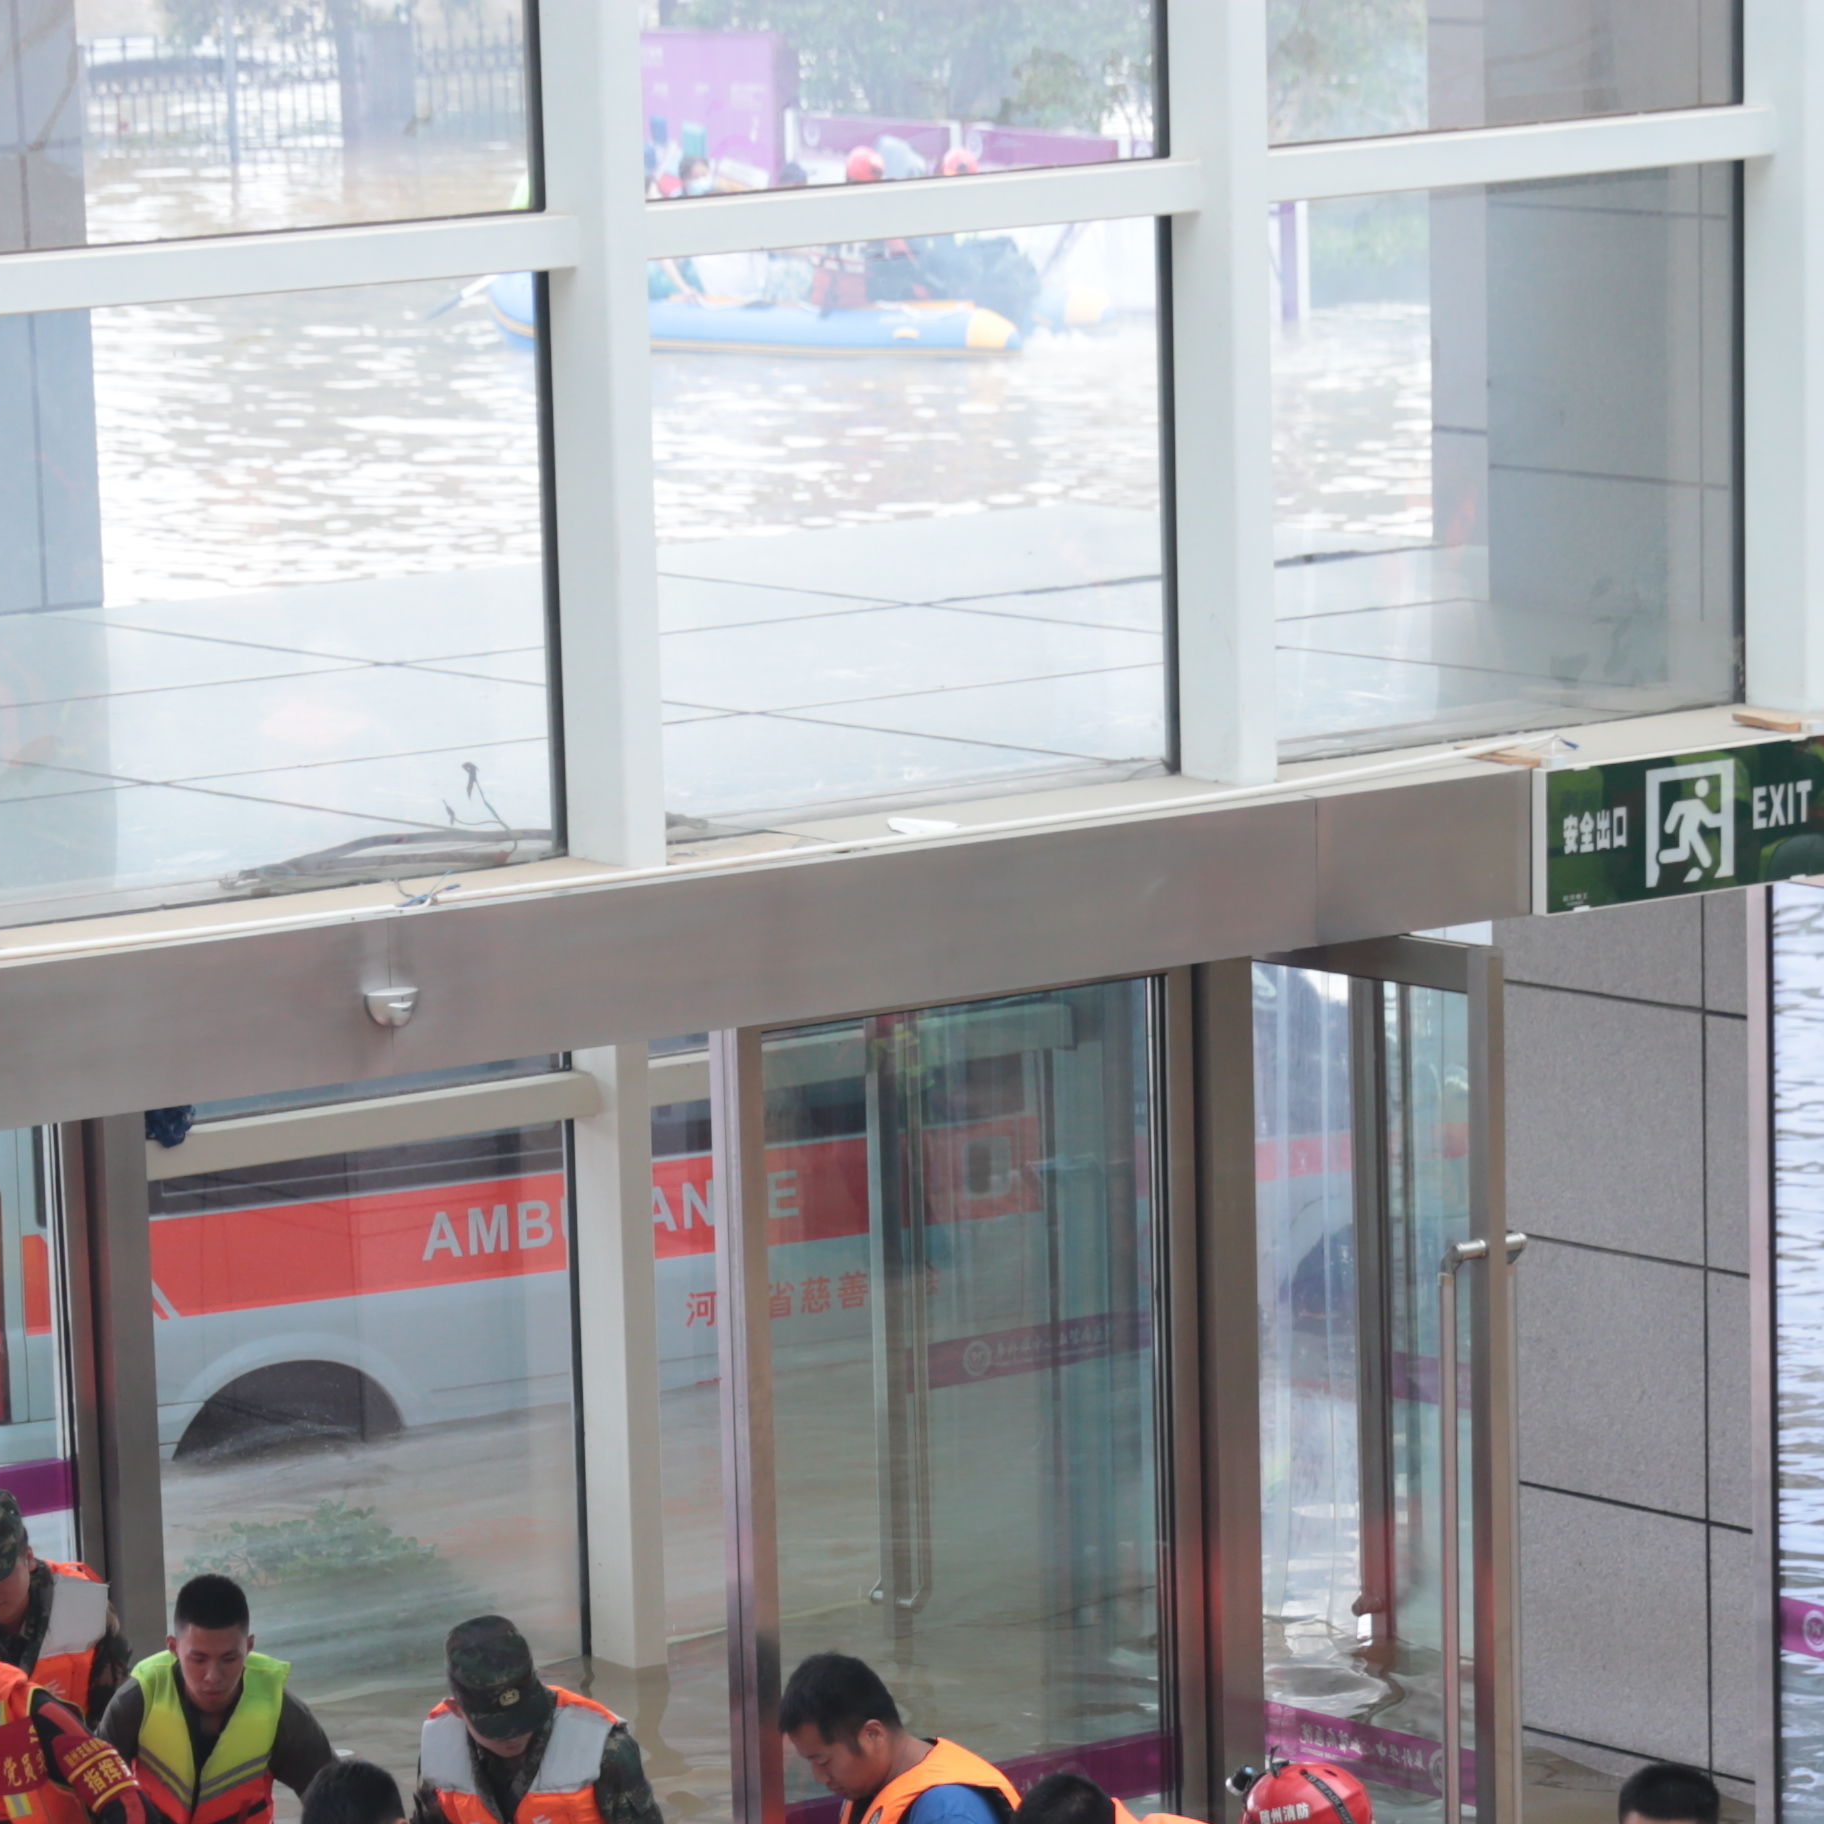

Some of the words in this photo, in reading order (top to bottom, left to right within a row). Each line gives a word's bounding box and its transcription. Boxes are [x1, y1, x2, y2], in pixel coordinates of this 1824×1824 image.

[1752, 780, 1812, 830] EXIT
[1563, 806, 1628, 855] 安全出口
